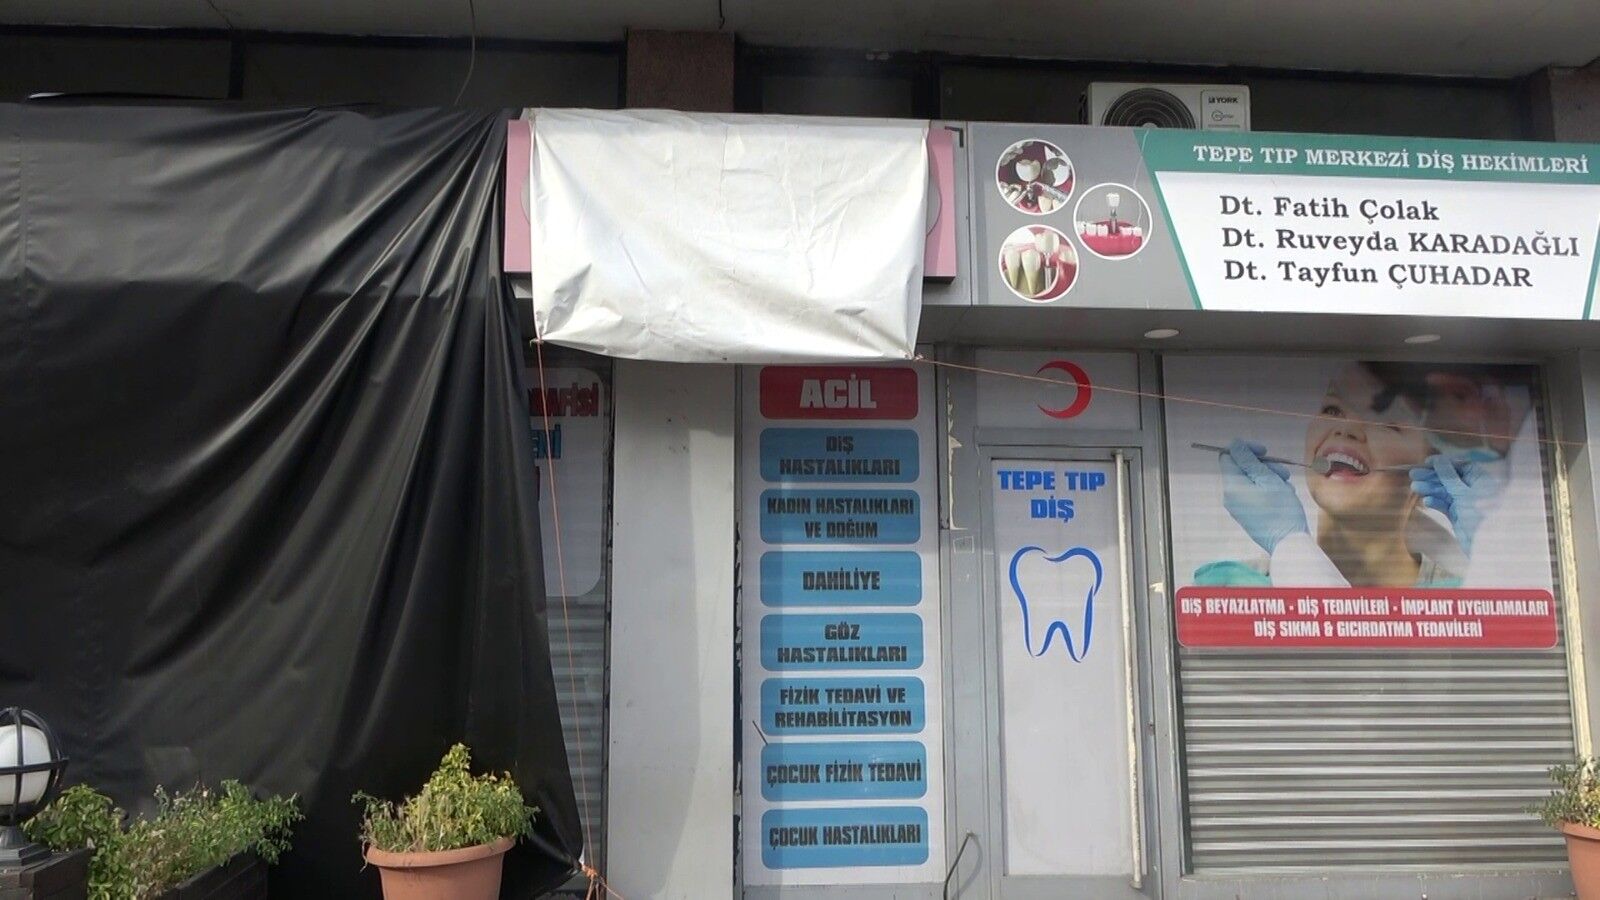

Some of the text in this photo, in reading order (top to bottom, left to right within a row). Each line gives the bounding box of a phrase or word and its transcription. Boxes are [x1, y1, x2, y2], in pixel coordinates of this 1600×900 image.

[1216, 96, 1239, 104] YORK
[1193, 145, 1589, 174] TEPE TIP MERKEZİ DİŞ HEKİMLERİ
[1219, 195, 1440, 225] Dt. Fatih Çolak
[1222, 227, 1580, 257] Dt. Ruveyda KARADAĞLI
[1224, 259, 1533, 290] Dt. Tayfun ÇUHADAR
[800, 374, 877, 409] ACİL
[779, 458, 900, 476] HASTALIKLARI
[997, 470, 1105, 491] TEPE TIP
[767, 497, 914, 515] KADIN HASTALIKLARI
[1030, 495, 1075, 523] DİŞ
[804, 519, 878, 538] VE DOĞUM
[802, 567, 881, 591] DAHİLİYE
[1206, 599, 1286, 615] BEYAZLATMA
[1298, 596, 1319, 617] DİŞ
[1322, 596, 1389, 615] TEDAVİLERİ
[1401, 596, 1454, 615] İMPLANT
[1458, 600, 1549, 616] UYGULAMALARI
[824, 622, 861, 641] GÖZ
[1254, 618, 1483, 640] DİŞ SIKMA & GICIRDATMA TEDAVİLERİ
[777, 646, 907, 663] HASTALIKLARI
[780, 684, 906, 705] FİZİK TEDAVİ VE
[774, 708, 912, 728] REHABİLİTASYON
[766, 759, 922, 788] ÇOCUK FİZİK TEDAVİ
[769, 823, 921, 850] ÇOCUK HASTALIKLARI
